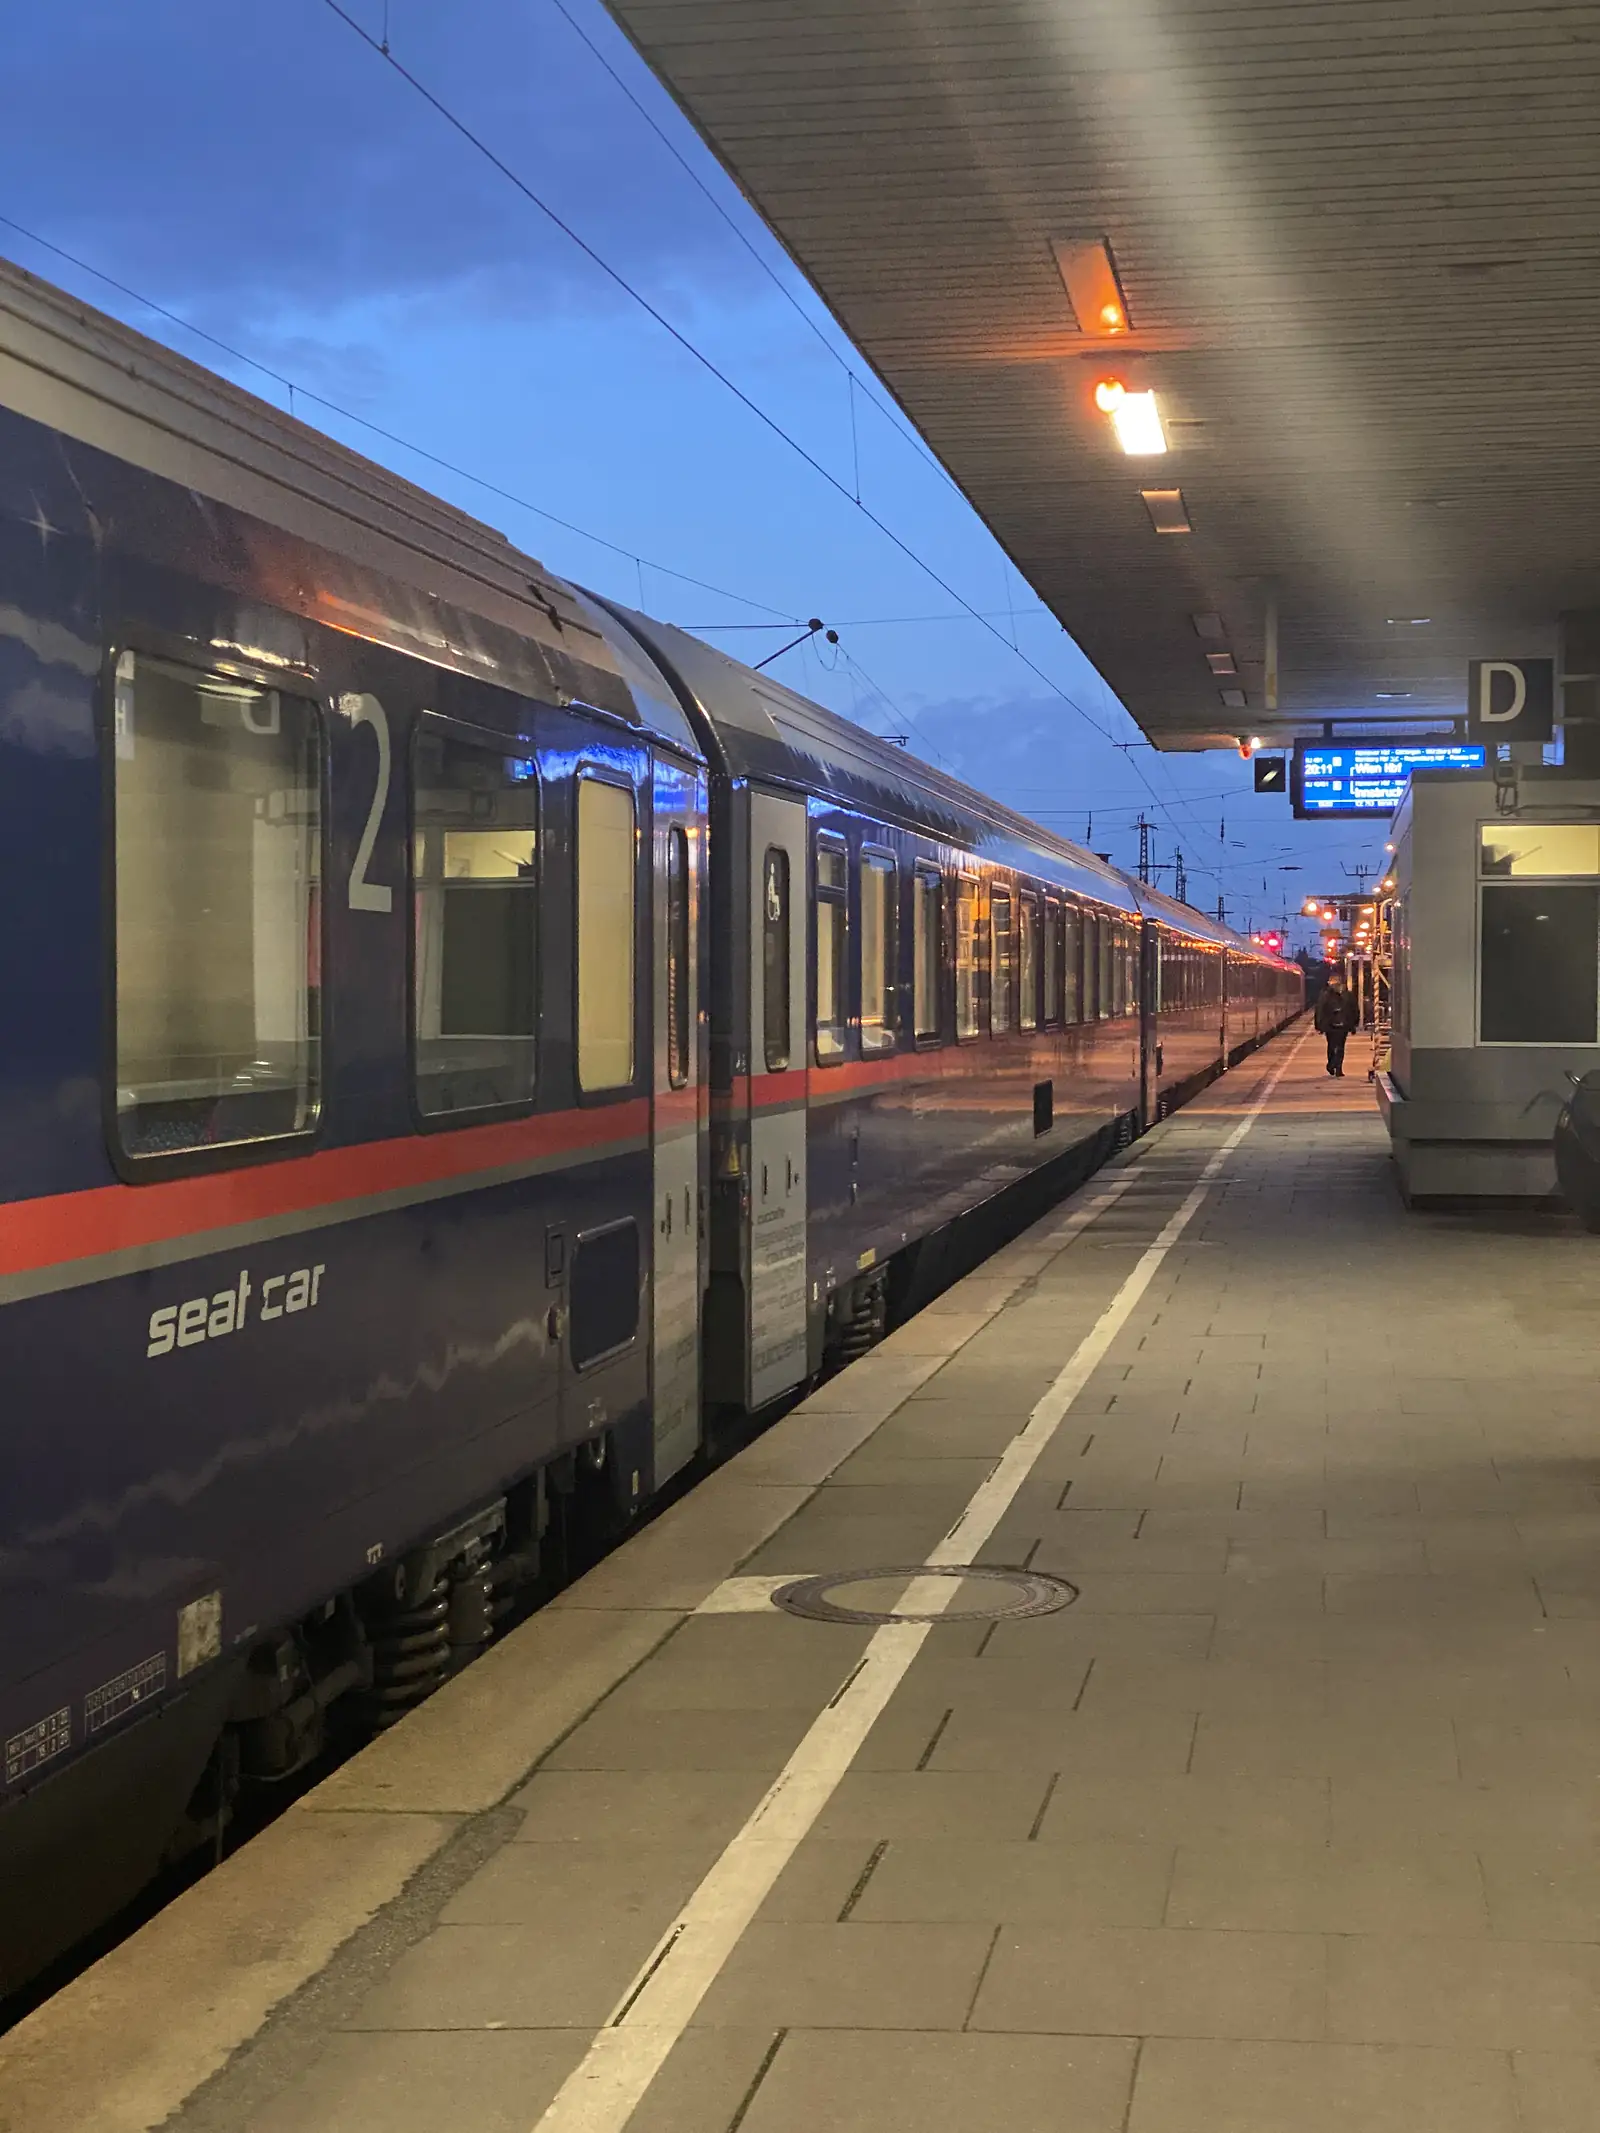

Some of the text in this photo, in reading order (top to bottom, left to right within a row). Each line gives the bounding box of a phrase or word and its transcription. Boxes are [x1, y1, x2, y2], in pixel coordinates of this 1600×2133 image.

[1480, 663, 1527, 722] D
[339, 692, 392, 912] 2
[147, 1264, 325, 1358] seat car
